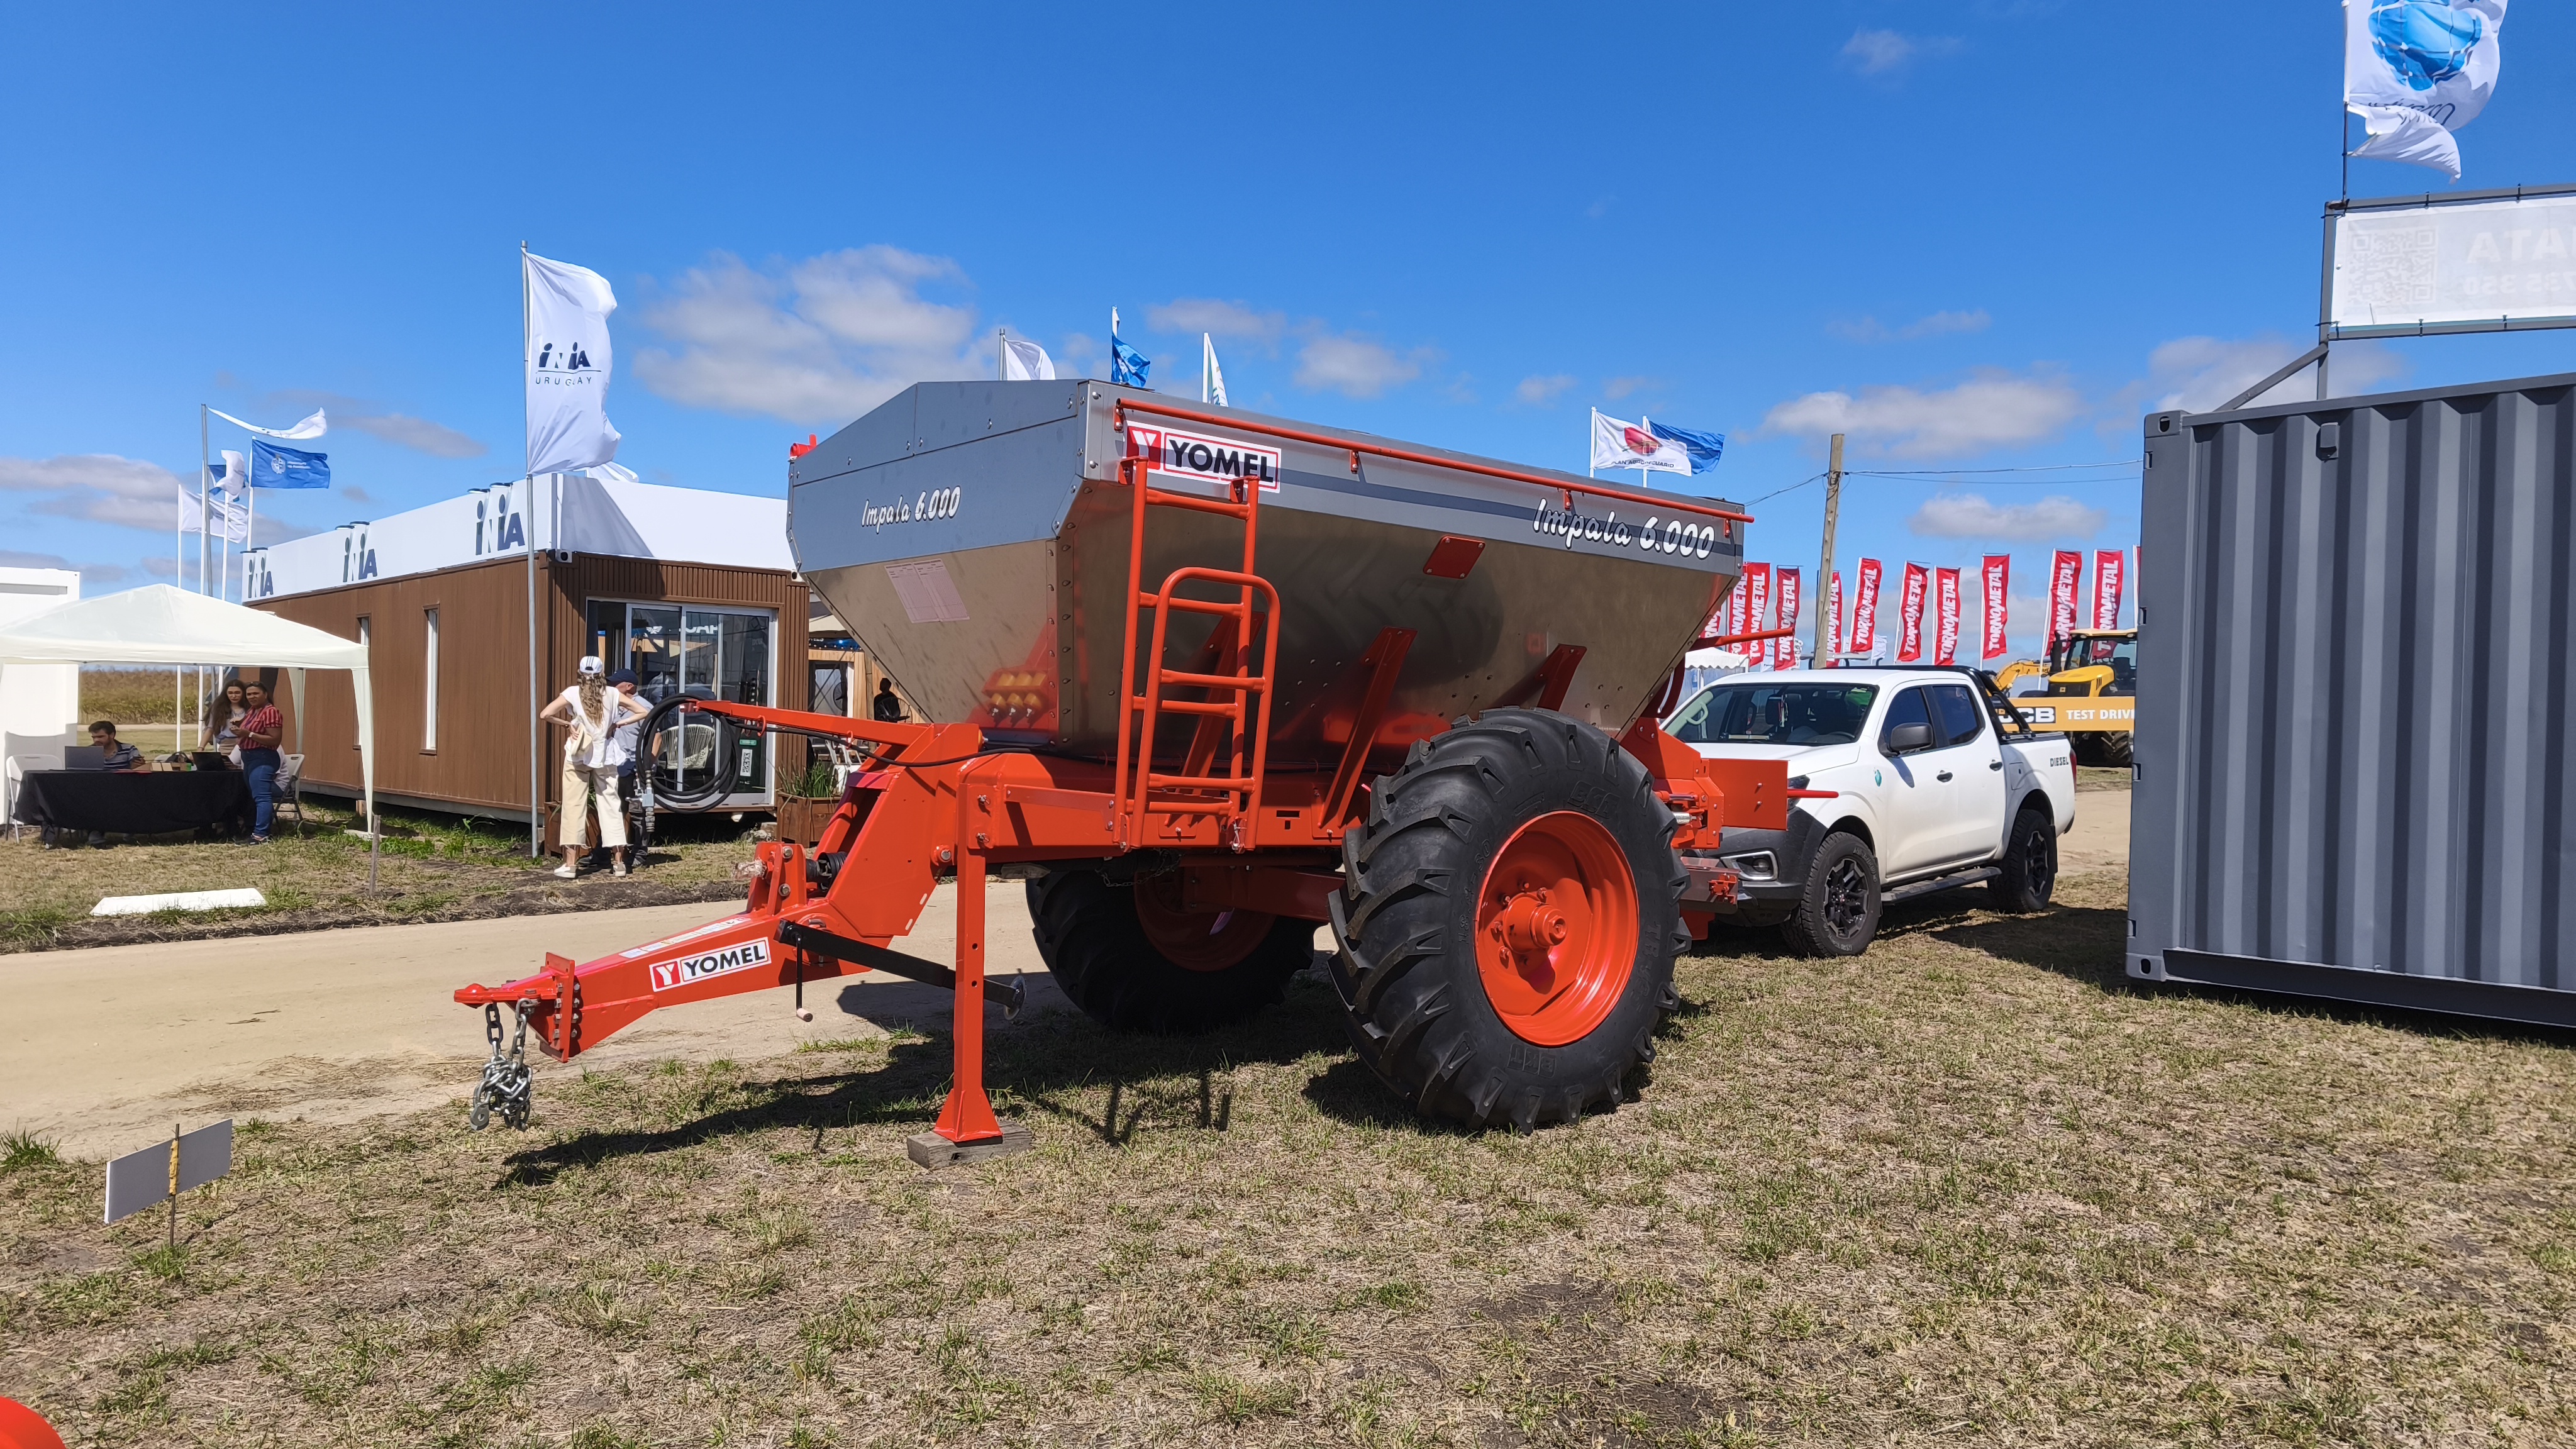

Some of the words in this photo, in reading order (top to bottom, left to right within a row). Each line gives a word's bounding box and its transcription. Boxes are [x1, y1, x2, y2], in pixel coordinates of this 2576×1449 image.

[1169, 439, 1274, 483] YOMEL
[862, 499, 911, 535] Impala
[914, 486, 962, 522] 6.000
[1533, 497, 1633, 550] Impala
[1639, 516, 1716, 560] 6.000
[1749, 572, 1765, 660] TONOMETAL
[1779, 577, 1796, 661] TOROMETAL
[1856, 568, 1877, 645] TORNOMETAL
[1904, 573, 1923, 653] TORNOMETAL
[1940, 576, 1959, 661] TORNOMETAL
[1988, 564, 2005, 651] TORNOMETAL
[2066, 709, 2096, 720] TEST
[2050, 757, 2069, 767] DIESEL
[684, 945, 765, 977] YOMEL
